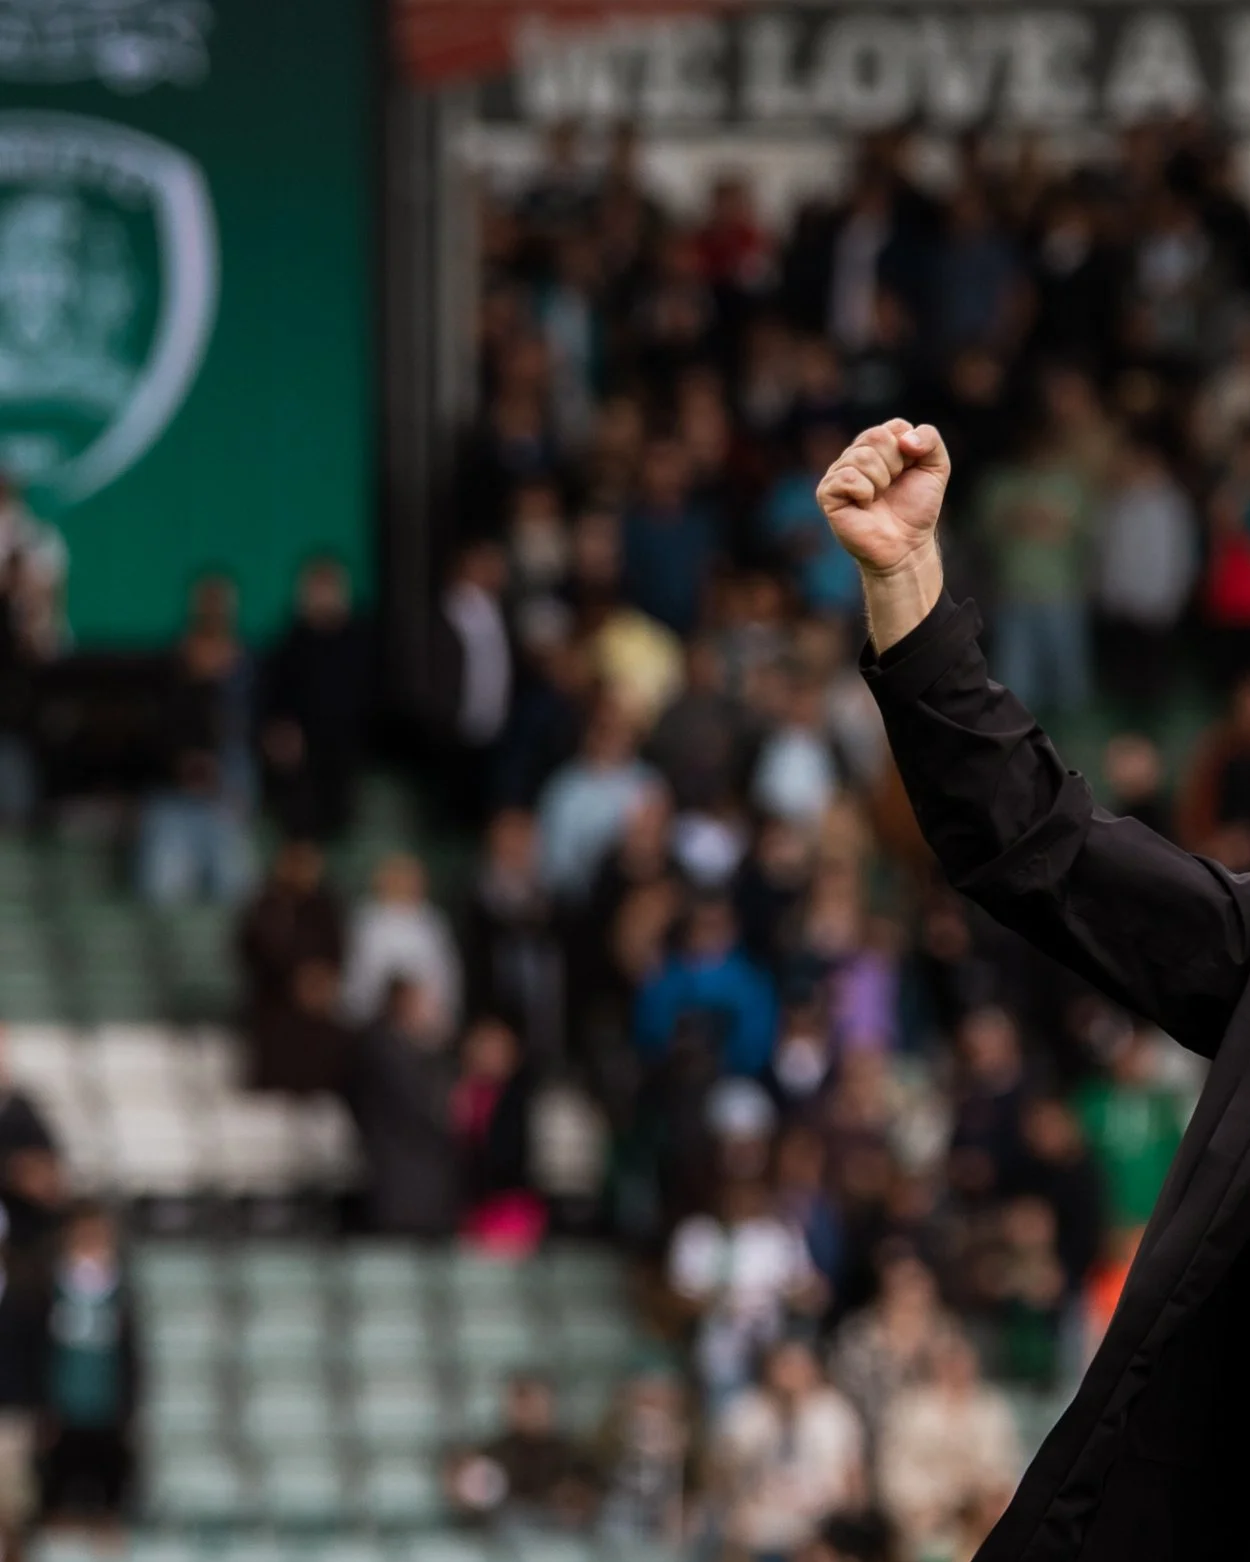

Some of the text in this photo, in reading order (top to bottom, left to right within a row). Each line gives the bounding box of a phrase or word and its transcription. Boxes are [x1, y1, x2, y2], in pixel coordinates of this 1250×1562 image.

[514, 12, 724, 122] WE
[740, 12, 1092, 128] LOVE
[1106, 12, 1204, 122] A
